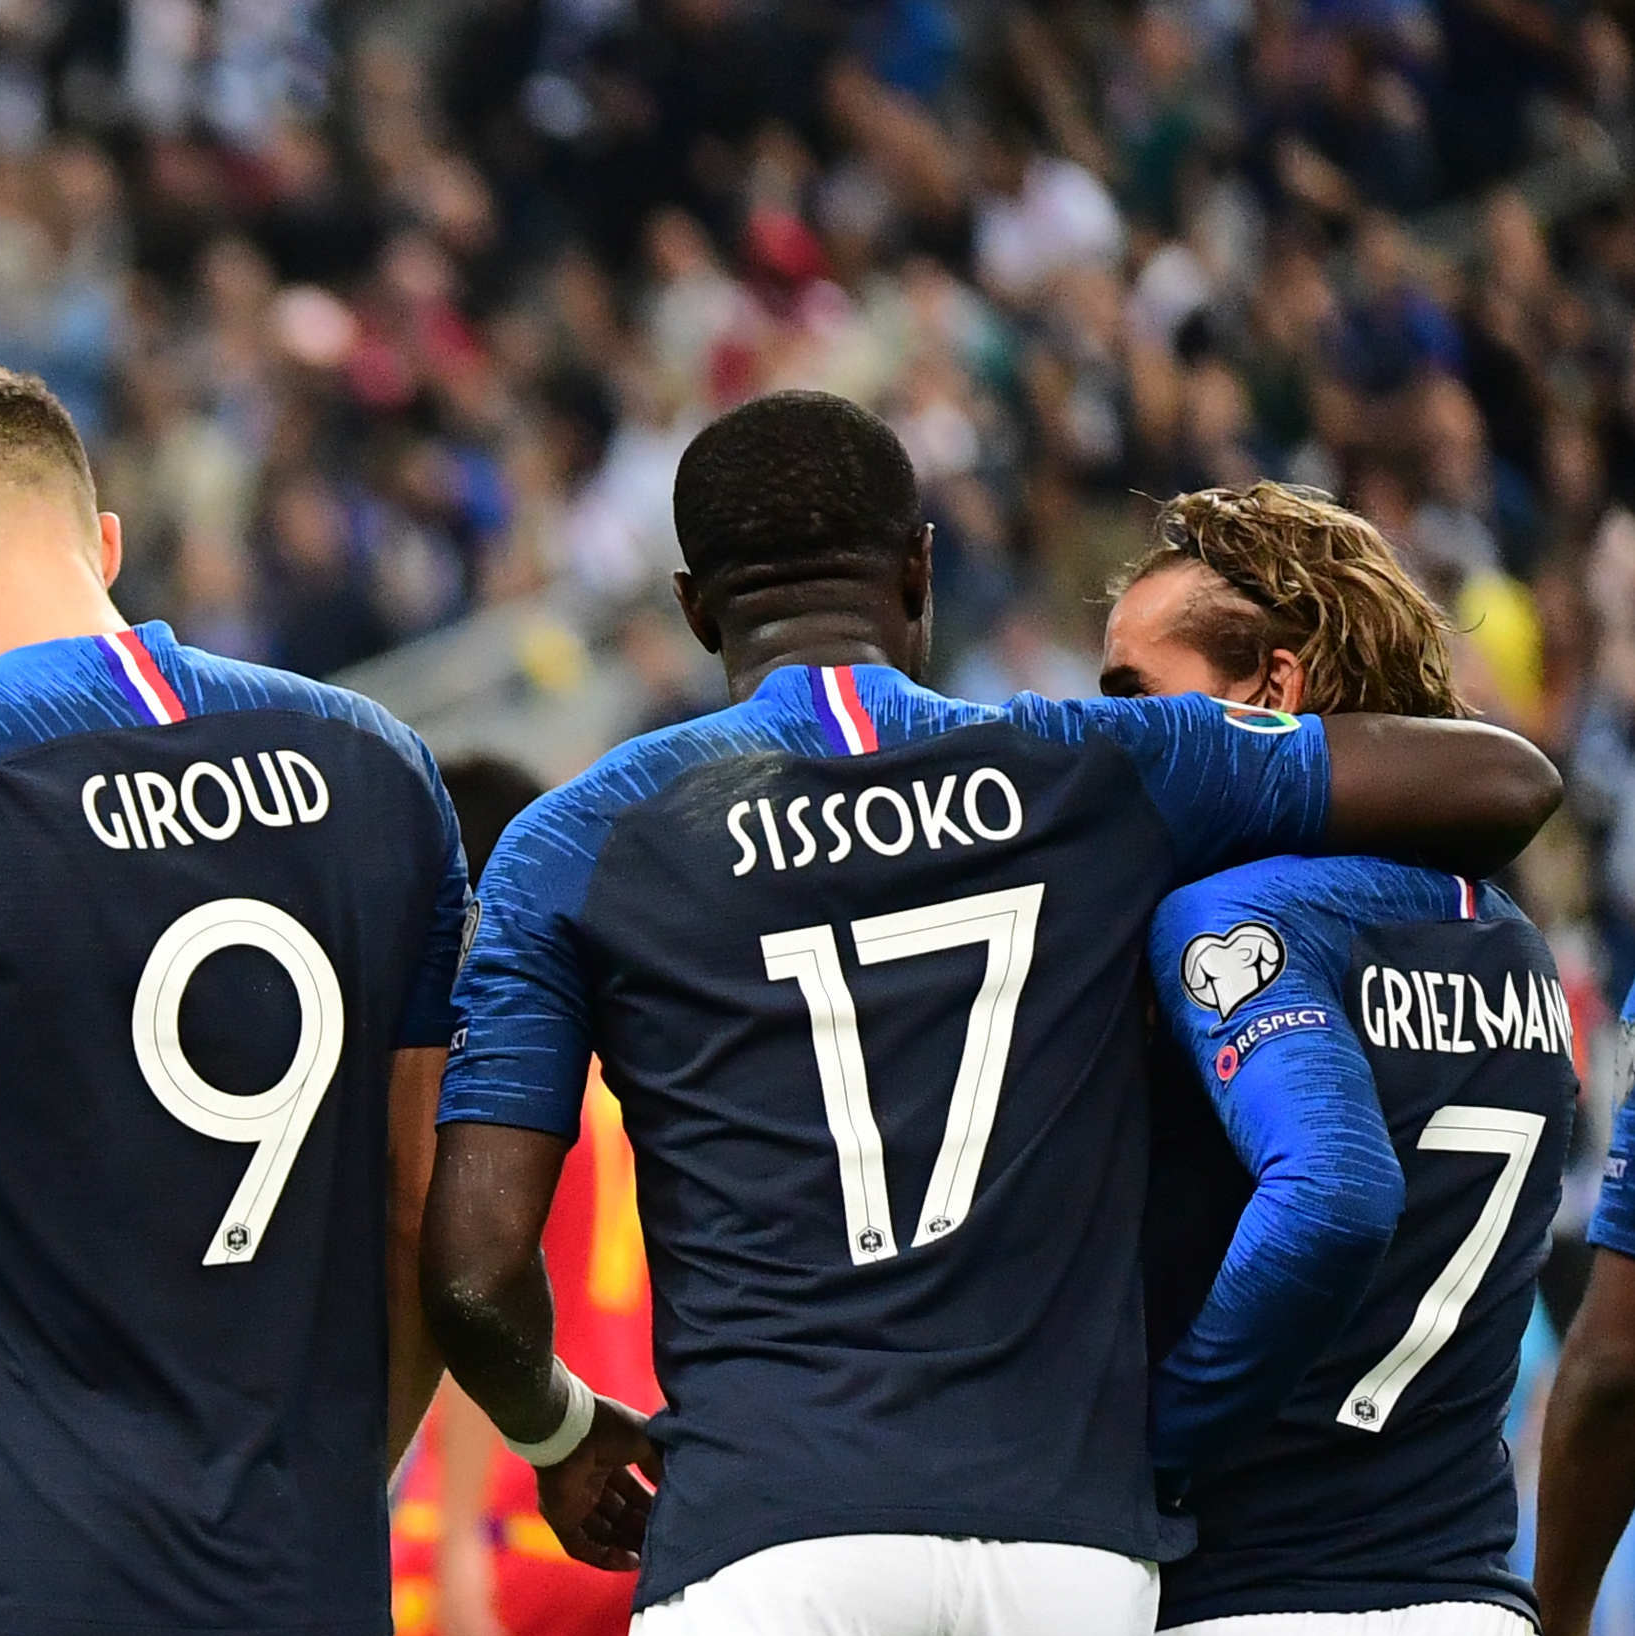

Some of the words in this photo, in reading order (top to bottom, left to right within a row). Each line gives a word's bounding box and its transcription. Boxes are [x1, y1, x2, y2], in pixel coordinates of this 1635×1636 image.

[82, 750, 329, 849] GIROUD
[727, 767, 1023, 877] SISSOKO
[1236, 1010, 1326, 1054] RESPECT
[1361, 964, 1573, 1062] GRIEZMAN
[132, 898, 344, 1266] 9
[760, 882, 1045, 1266] 17
[1336, 1105, 1547, 1433] 7
